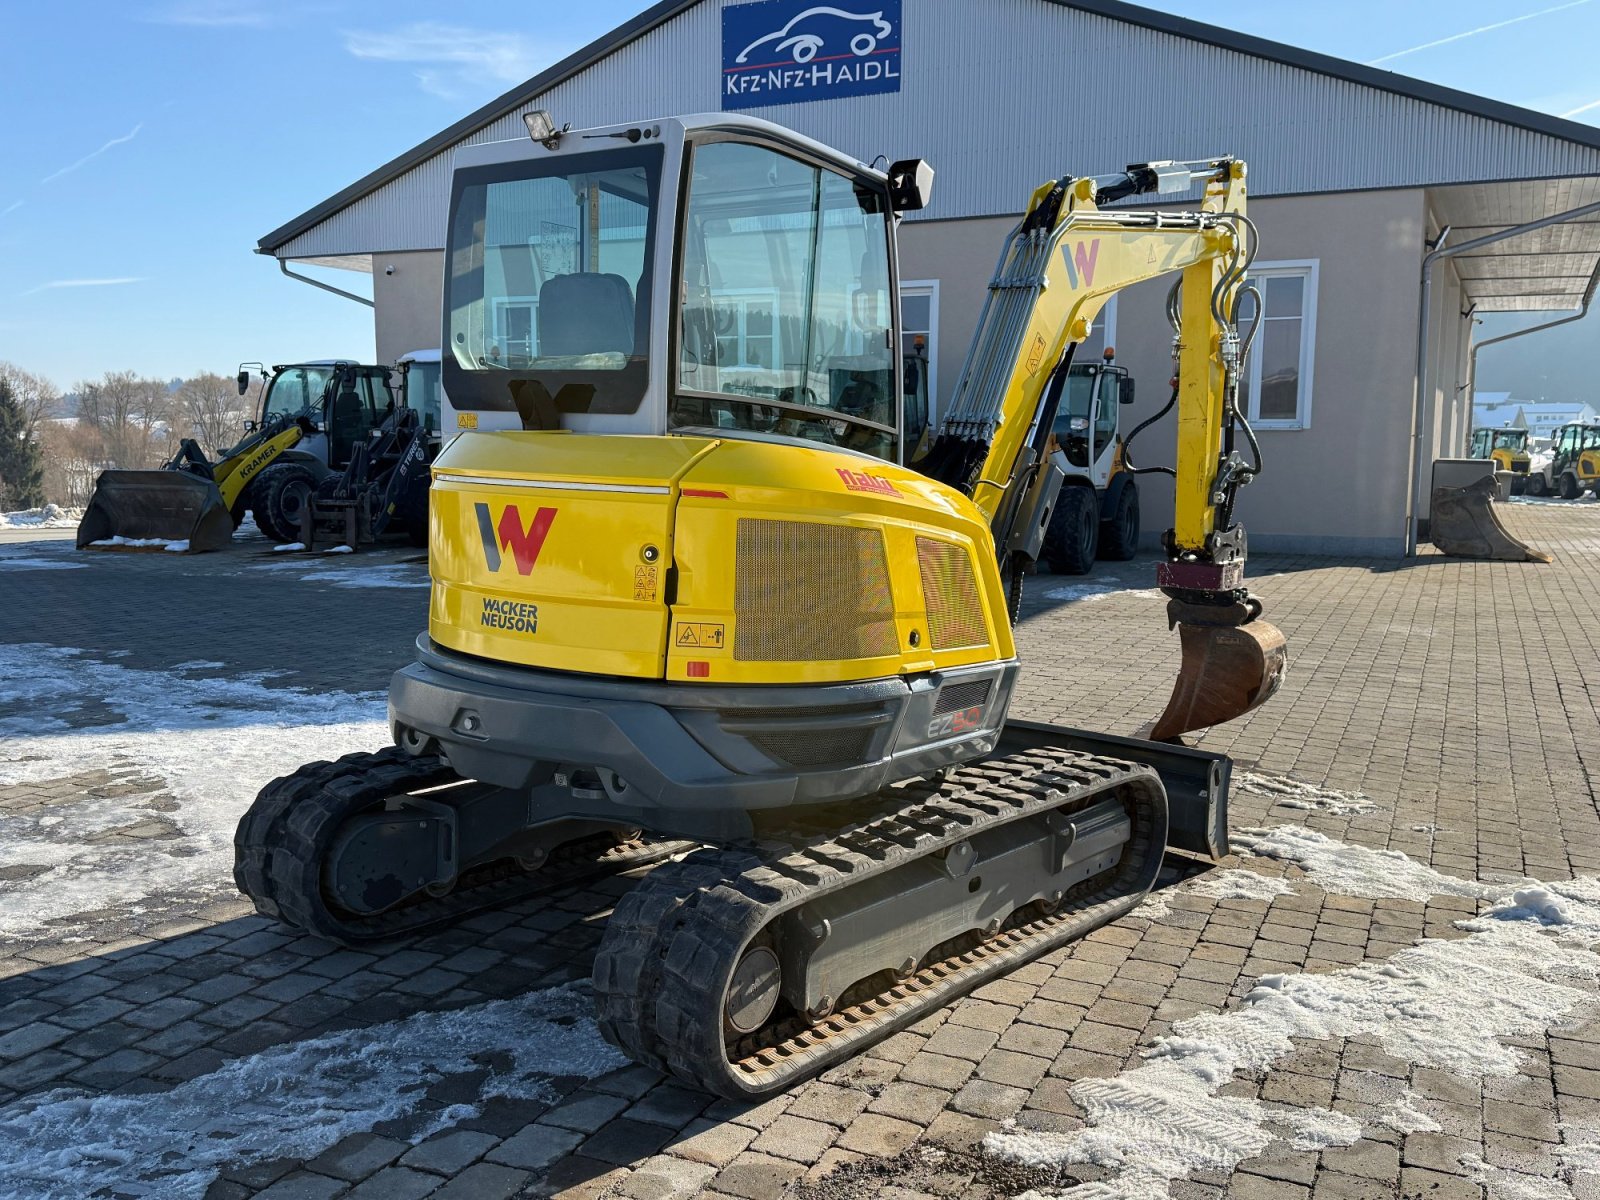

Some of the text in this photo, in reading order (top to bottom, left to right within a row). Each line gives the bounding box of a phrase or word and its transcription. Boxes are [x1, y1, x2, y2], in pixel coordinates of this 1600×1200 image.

[239, 445, 277, 479] KRAMER
[404, 437, 421, 466] TEREX
[482, 597, 538, 620] WACKER
[480, 611, 538, 634] NEUSON
